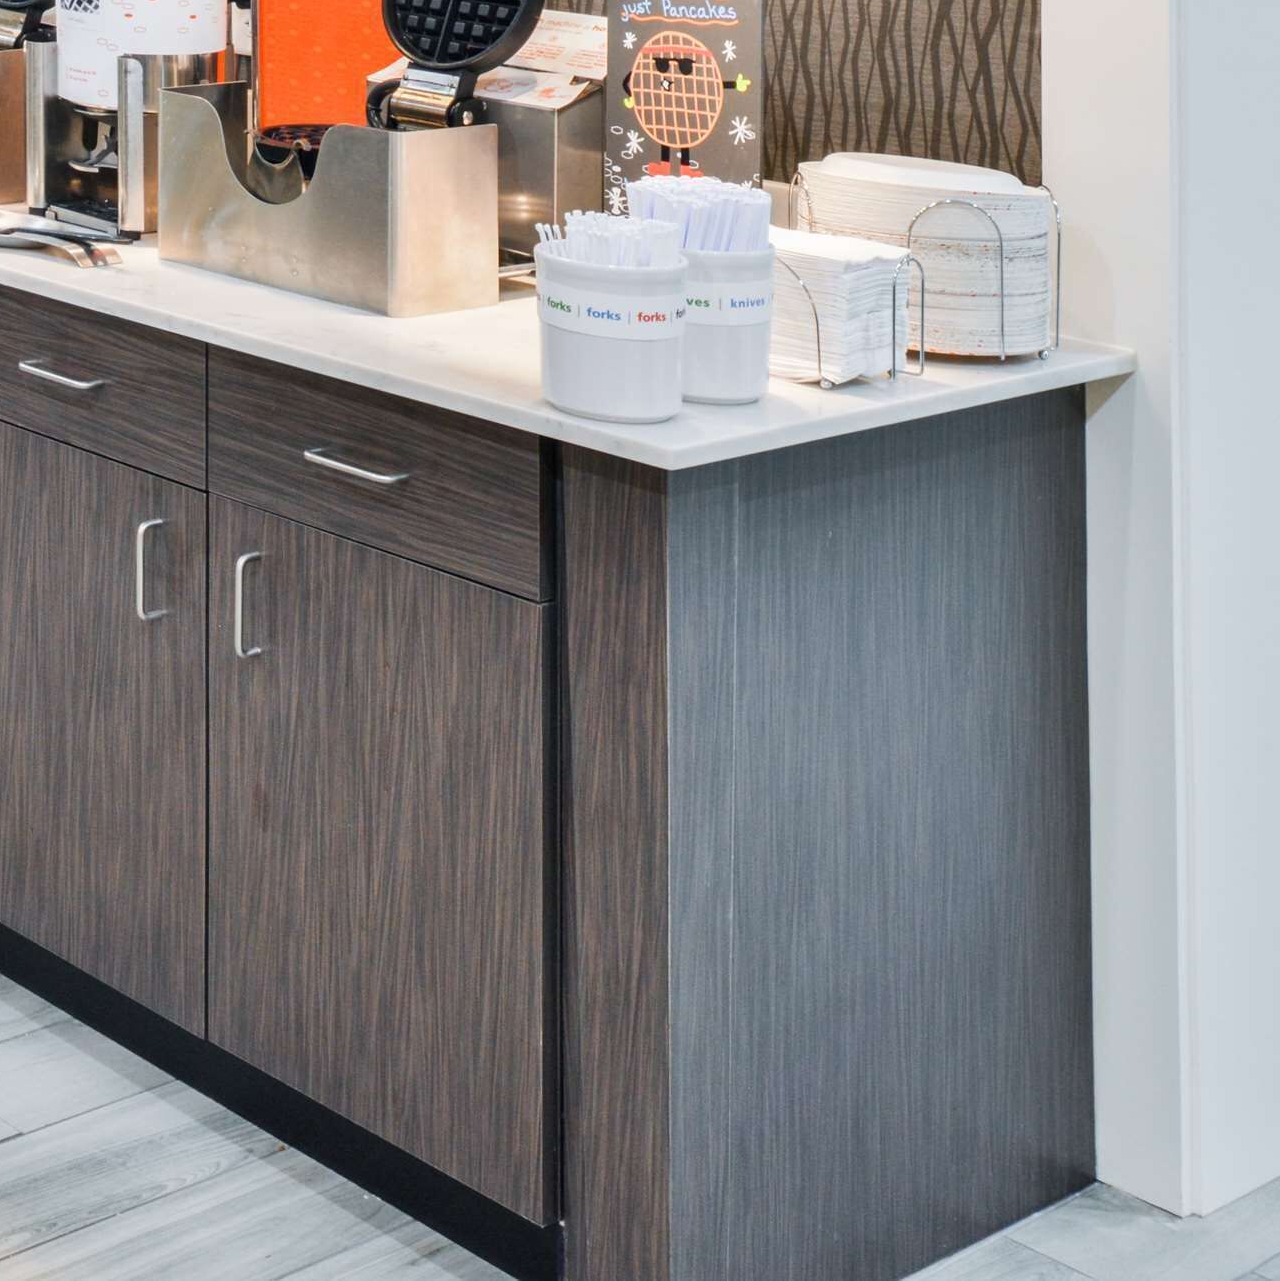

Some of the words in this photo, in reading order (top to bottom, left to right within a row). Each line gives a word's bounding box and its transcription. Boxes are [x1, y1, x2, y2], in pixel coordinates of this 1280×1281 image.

[546, 297, 572, 314] forks
[586, 307, 622, 321] forks
[637, 312, 667, 323] forks
[685, 298, 710, 308] ves
[730, 297, 766, 308] knives
